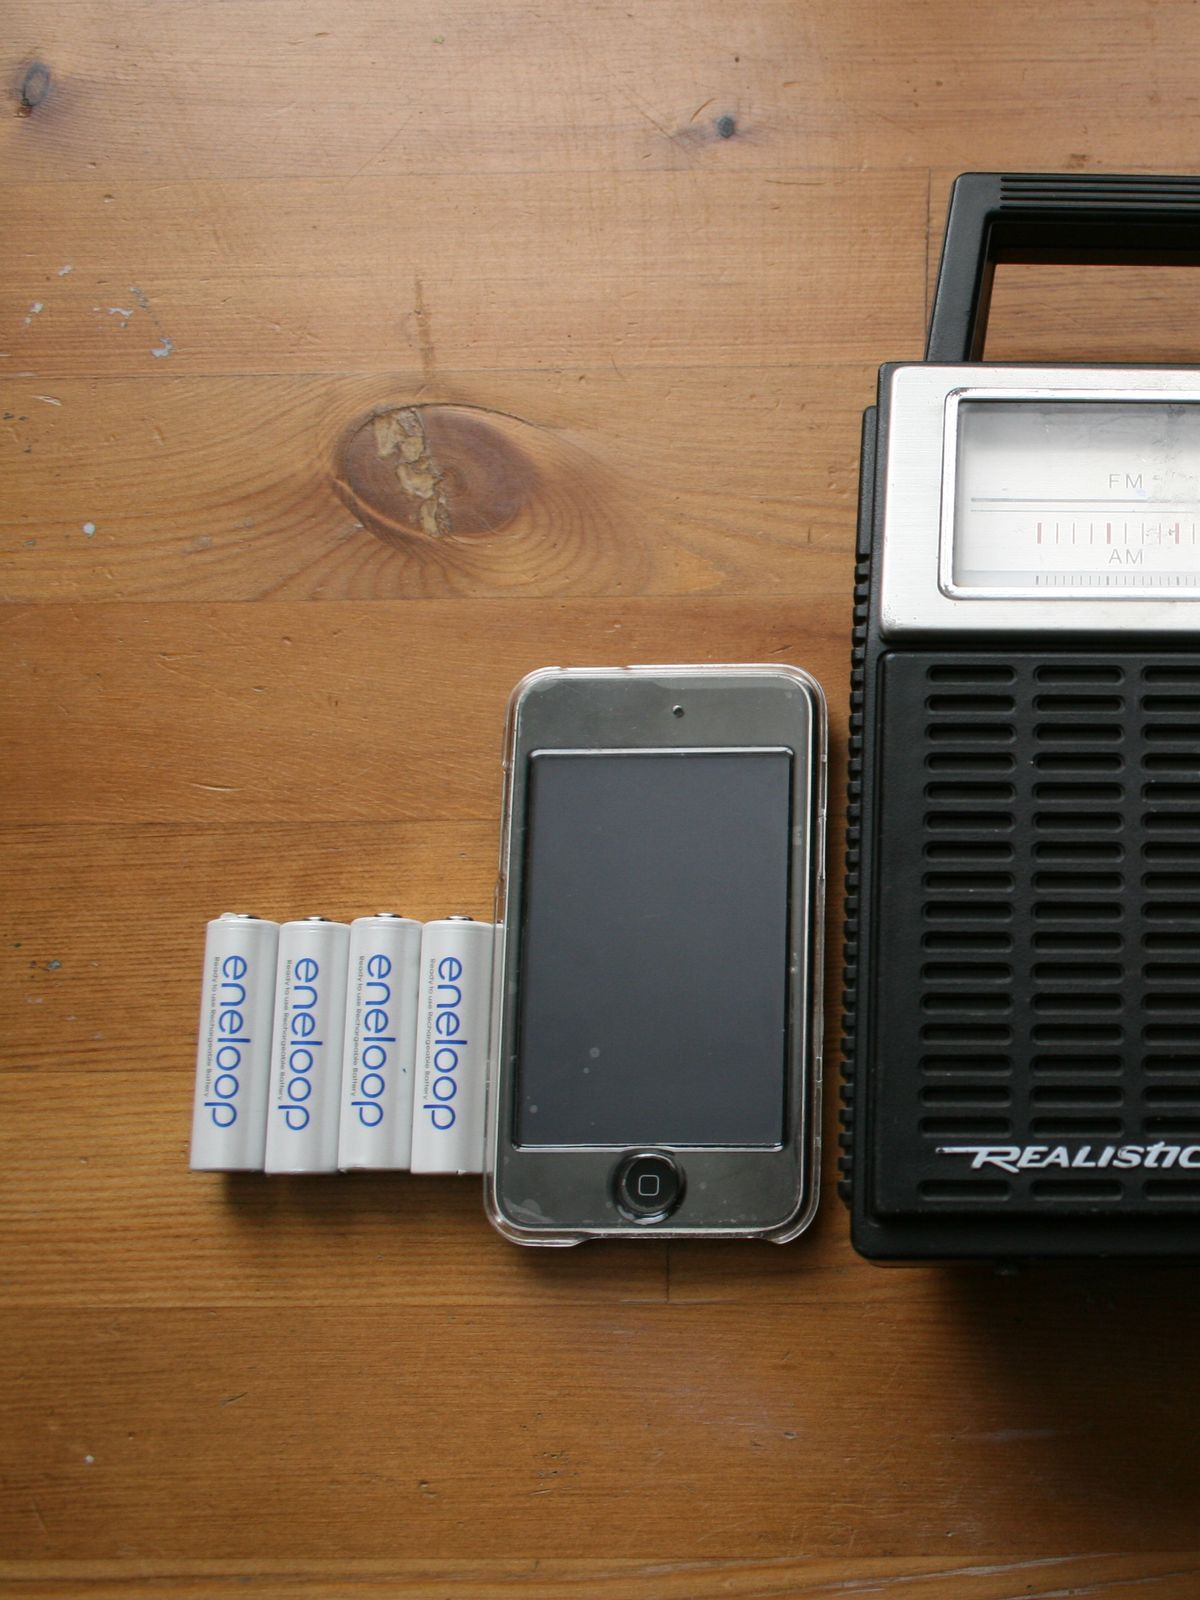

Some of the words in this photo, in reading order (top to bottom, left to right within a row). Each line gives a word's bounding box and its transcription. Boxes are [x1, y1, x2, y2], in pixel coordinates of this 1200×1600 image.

[1108, 472, 1144, 489] FM
[1108, 548, 1144, 565] AM
[211, 956, 220, 982] Ready
[283, 959, 292, 985] Ready
[356, 955, 365, 982] Ready
[427, 958, 436, 985] Ready
[204, 955, 251, 1128] eneloop
[278, 957, 323, 1131] eneloop
[351, 954, 396, 1127] eneloop
[423, 956, 467, 1130] eneloop
[203, 1068, 212, 1098] Battery
[277, 1071, 285, 1101] Battery
[350, 1067, 358, 1097] Battery
[422, 1070, 431, 1100] Battery
